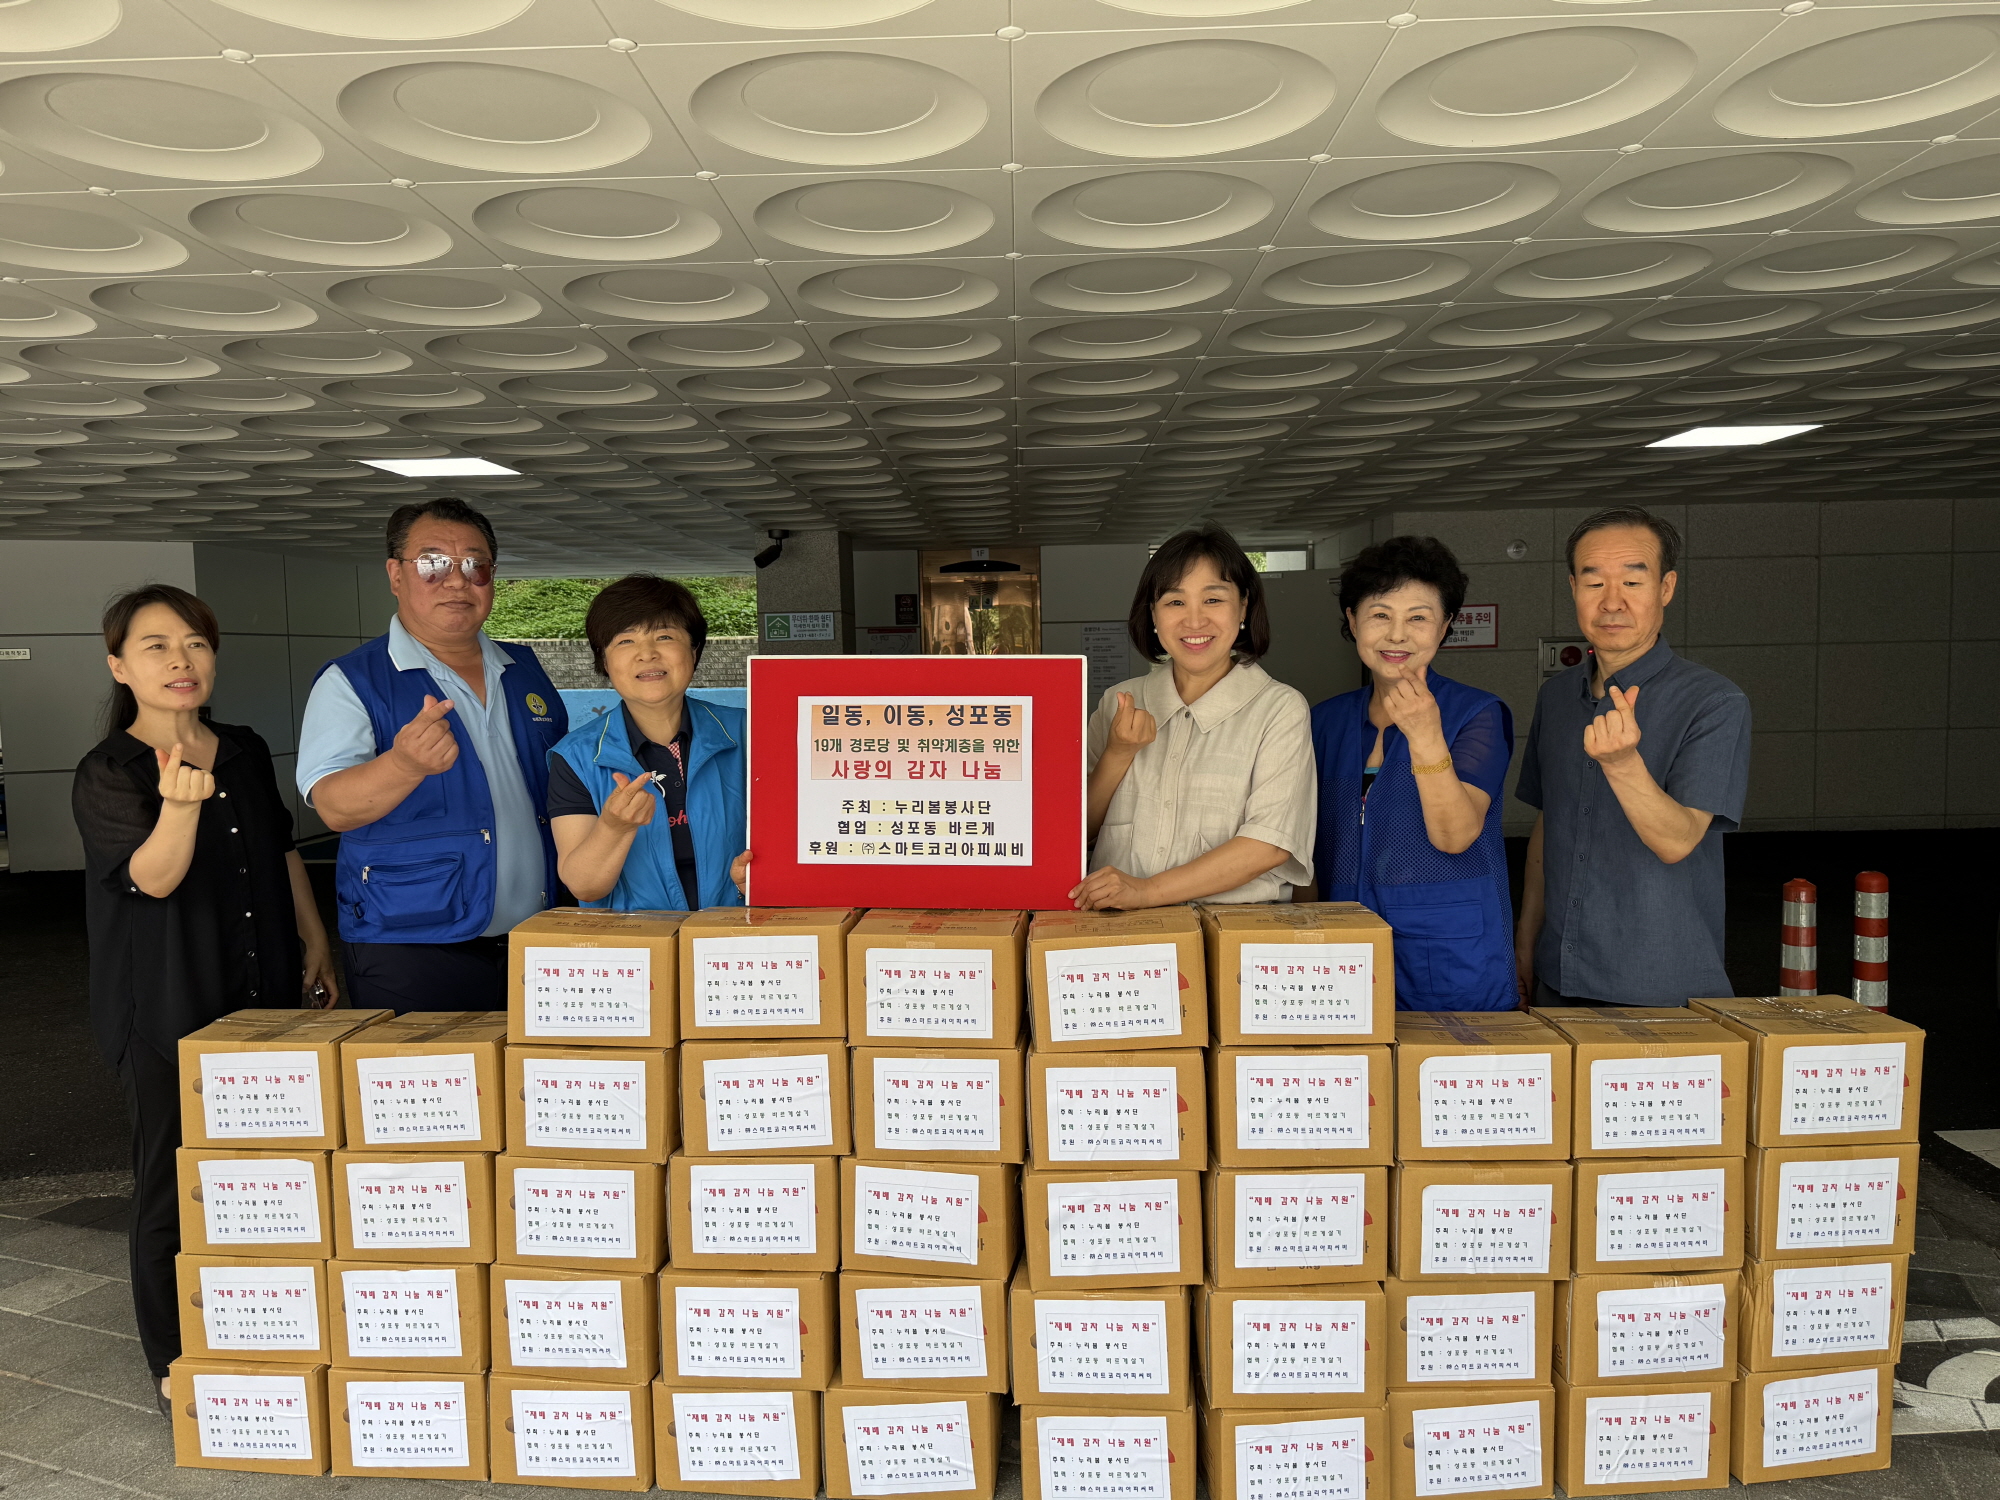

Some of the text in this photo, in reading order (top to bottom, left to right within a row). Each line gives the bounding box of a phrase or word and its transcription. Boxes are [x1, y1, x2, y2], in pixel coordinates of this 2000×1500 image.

[1475, 611, 1491, 624] 주의
[822, 705, 1011, 726] 일동, 이동, 성포동
[814, 738, 1020, 753] 19개 경로당 및 취약계층을 위한
[832, 760, 1001, 779] 사랑의 감자 나눔
[842, 800, 870, 814] 주최
[895, 801, 991, 814] 누리봄봉사단
[838, 821, 866, 834] 협업
[891, 821, 936, 835] 성포동
[949, 822, 994, 835] 바르게
[809, 841, 837, 855] 후원
[862, 842, 1023, 857] ㈜스마트코리아피씨비
[736, 960, 754, 971] 감자
[761, 960, 778, 970] 나눔
[1286, 965, 1305, 975] 감자
[1312, 965, 1331, 975] 나눔
[1091, 972, 1110, 983] 감자
[1117, 970, 1136, 981] 나눔
[241, 1075, 258, 1085] 감자
[264, 1075, 282, 1085] 나눔
[1636, 1081, 1655, 1091] 감자
[1661, 1080, 1680, 1090] 나눔
[388, 1184, 405, 1195] 감자
[411, 1184, 428, 1194] 나눔
[1821, 1183, 1838, 1193] 감자
[1844, 1182, 1861, 1192] 나눔
[555, 1189, 573, 1199] 감자
[579, 1189, 596, 1200] 나눔
[1280, 1196, 1299, 1206] 감자
[1305, 1195, 1324, 1206] 나눔
[1467, 1208, 1486, 1219] 감자
[1493, 1208, 1511, 1218] 나눔
[899, 1309, 917, 1319] 감자
[924, 1308, 942, 1319] 나눔
[1278, 1322, 1297, 1332] 감자
[1304, 1322, 1323, 1332] 나눔
[387, 1401, 404, 1411] 감자
[410, 1401, 427, 1411] 나눔
[1803, 1398, 1820, 1409] 감자
[1826, 1395, 1842, 1406] 나눔
